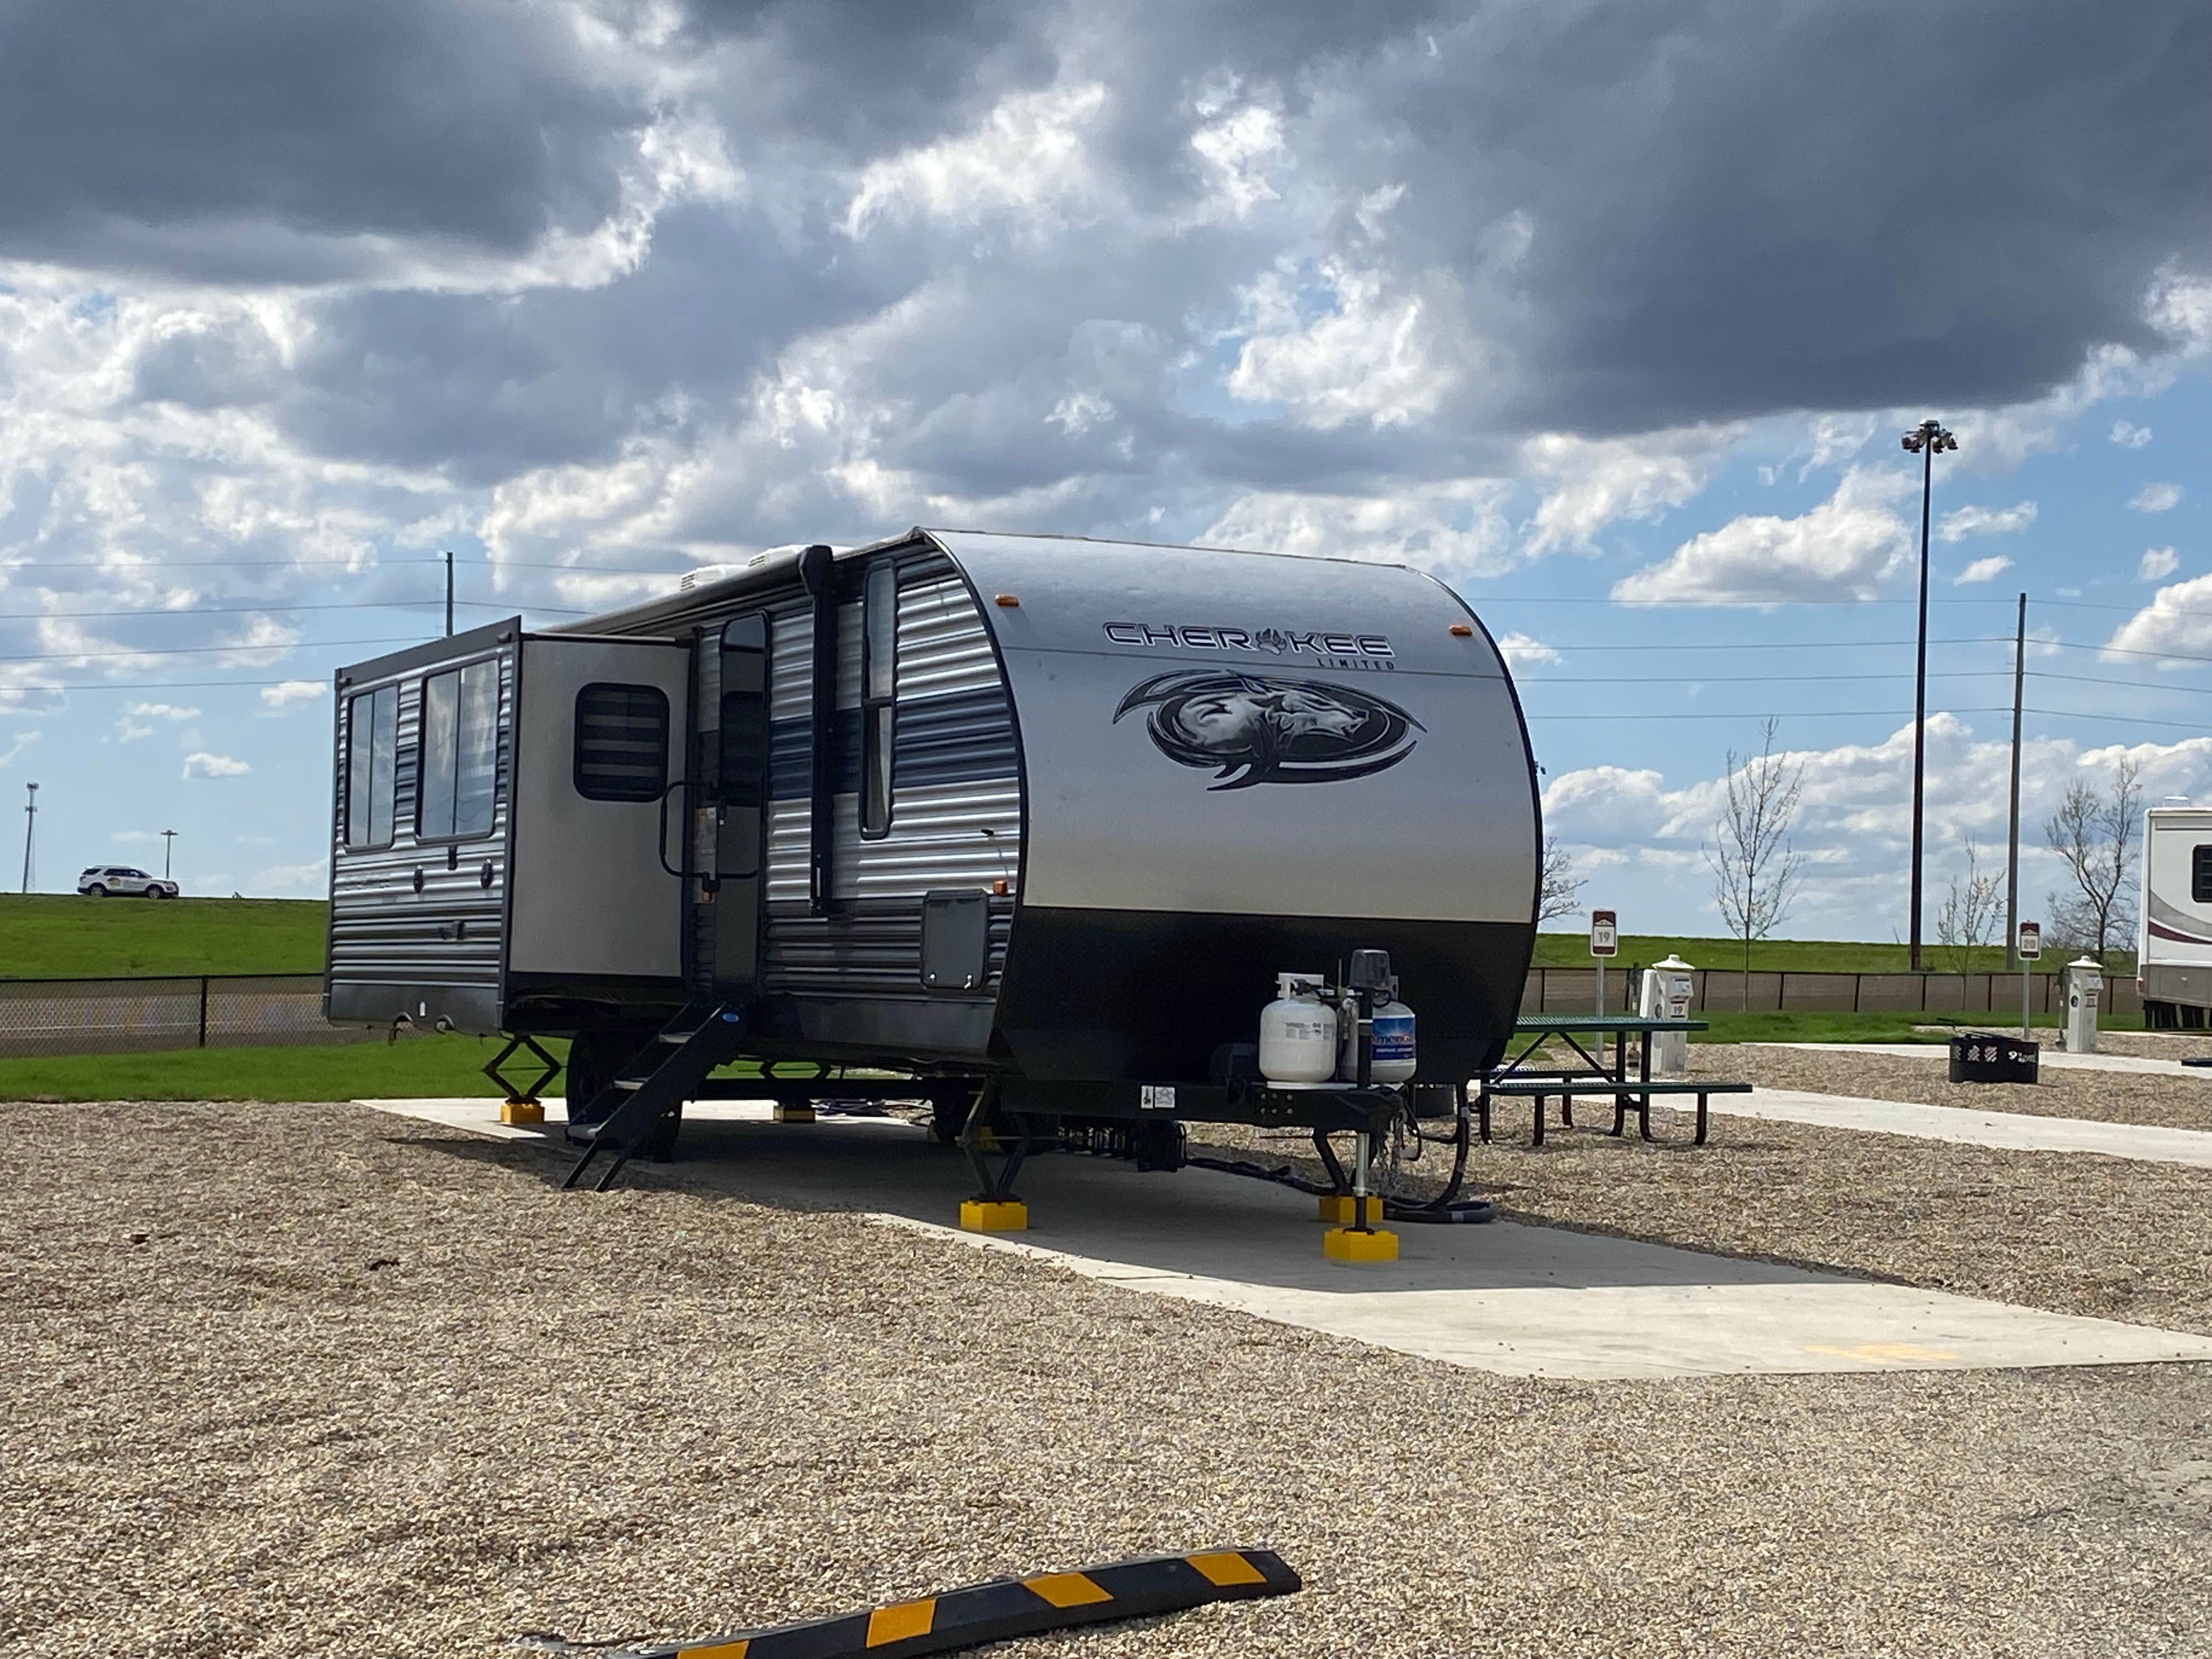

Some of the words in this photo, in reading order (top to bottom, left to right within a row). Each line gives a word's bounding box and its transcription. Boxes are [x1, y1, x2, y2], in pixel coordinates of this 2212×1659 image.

[1317, 658, 1395, 670] LIMITED
[1599, 932, 1610, 943] 19
[2024, 939, 2036, 949] 20
[1673, 1005, 1683, 1014] 19
